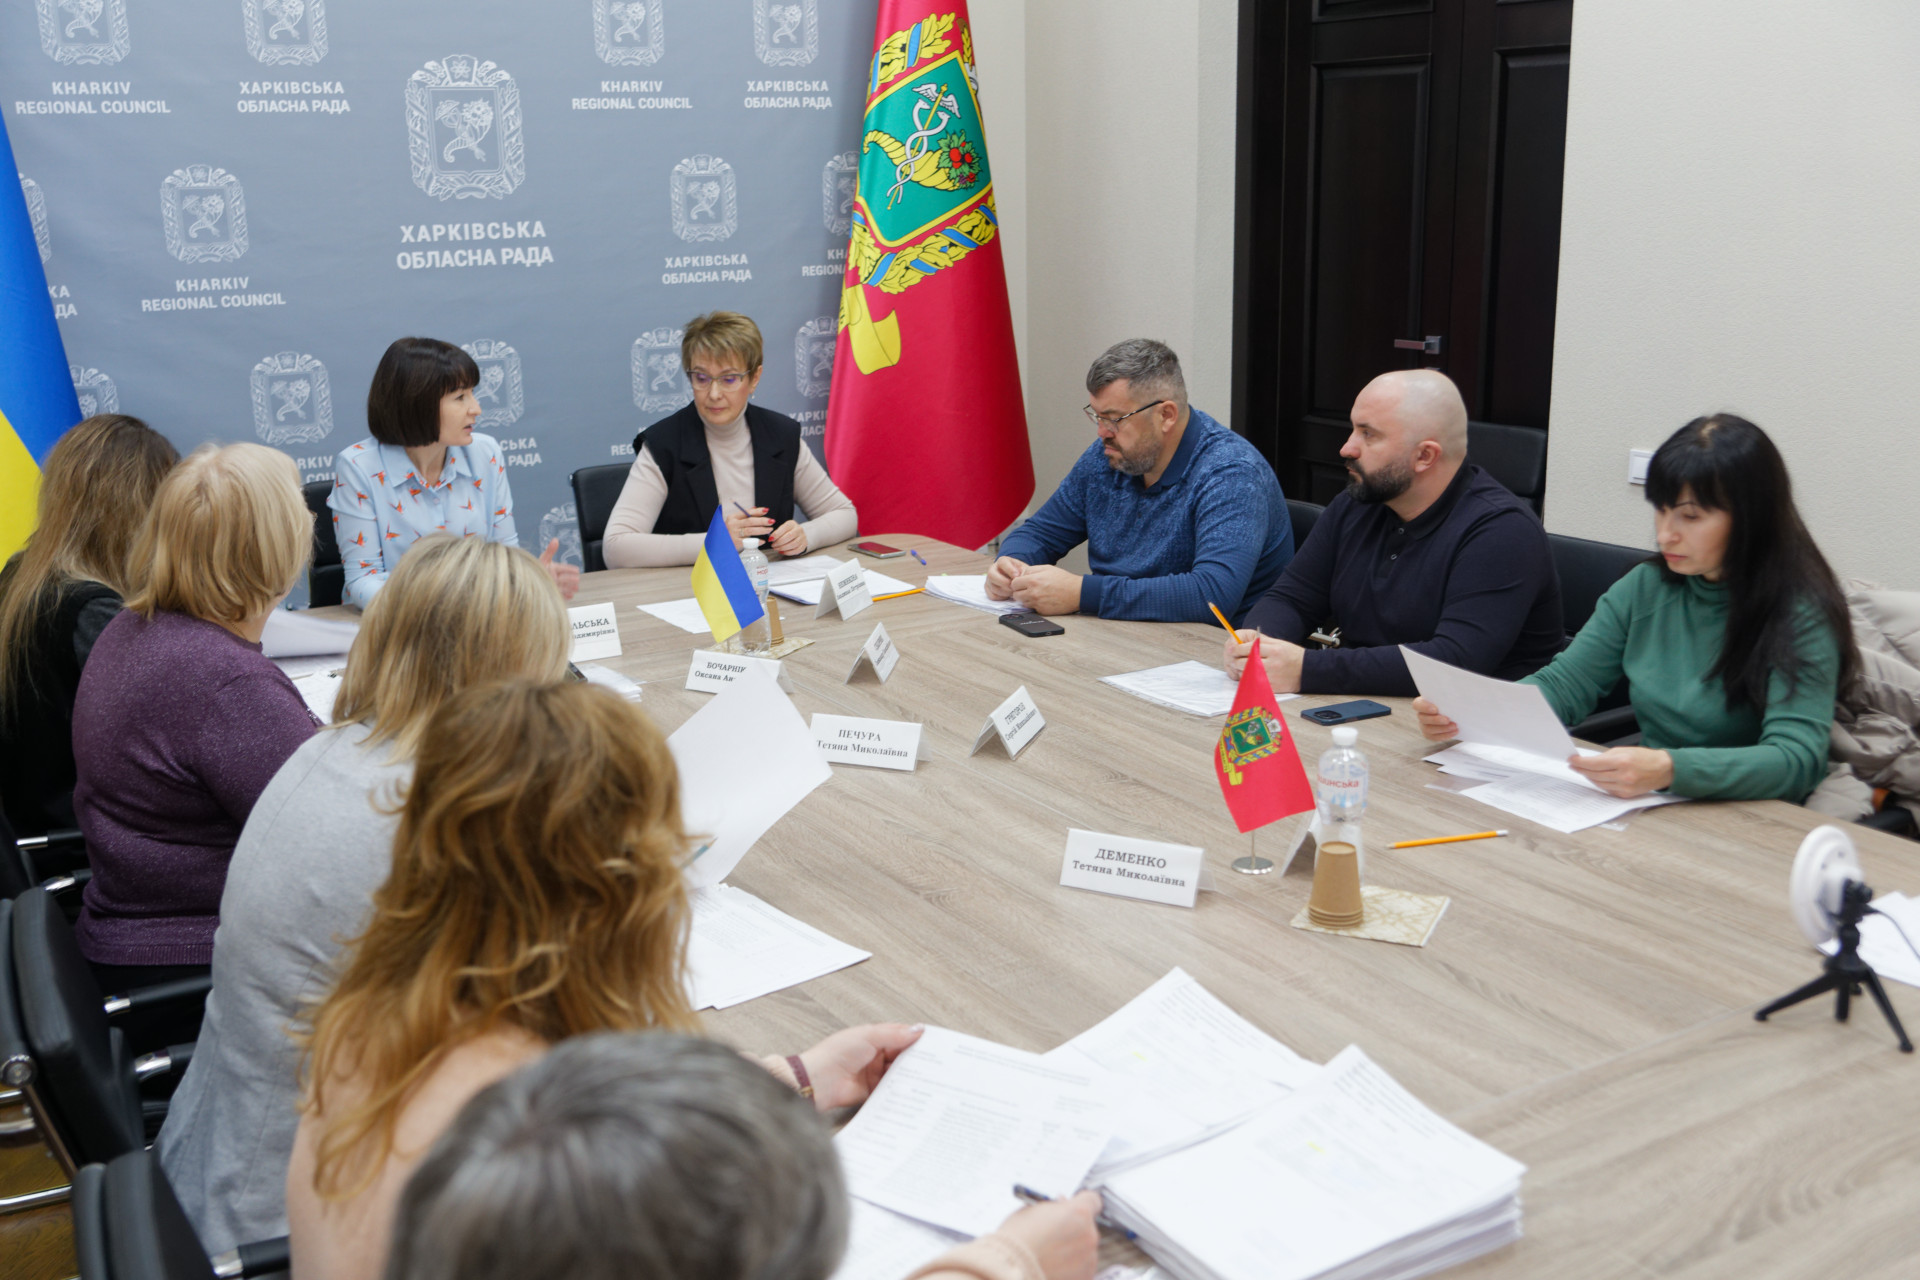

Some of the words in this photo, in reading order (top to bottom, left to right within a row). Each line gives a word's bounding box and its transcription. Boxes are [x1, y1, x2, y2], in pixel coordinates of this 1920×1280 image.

[52, 81, 131, 95] KHARKIV
[239, 81, 344, 94] ХАРКІВСЬКА
[601, 81, 663, 92] KHARKIV
[747, 80, 829, 92] ХАРКІВСЬКА
[15, 101, 97, 114] REGIONAL
[101, 100, 171, 114] COUNCIL
[237, 99, 309, 113] ОБЛАСНА
[311, 99, 351, 115] РАДА
[572, 97, 635, 110] REGIONAL
[638, 97, 693, 109] COUNCIL
[744, 97, 800, 109] ОБЛАСНА
[802, 97, 832, 110] РАДА
[400, 220, 546, 243] ХАРКІВСЬКА
[396, 249, 497, 270] ОБЛАСНА
[500, 246, 554, 268] РАДА
[664, 254, 749, 268] ХАРКІВСЬКА
[662, 271, 719, 285] ОБЛАСНА
[721, 269, 752, 282] РАДА
[801, 264, 843, 277] REGION
[175, 277, 249, 292] KHARKIV
[141, 296, 218, 312] REGIONAL
[220, 292, 287, 308] COUNCIL
[54, 303, 78, 319] ДА
[297, 455, 333, 469] RKIV
[508, 453, 542, 467] РАДА
[572, 618, 610, 630] ЛЬСЬКА
[706, 661, 747, 673] БОЧАРНІК
[694, 670, 721, 680] Оксана
[723, 674, 736, 682] Ан
[838, 729, 881, 741] ПЕЧУРА
[817, 740, 848, 751] Тетяна
[850, 743, 908, 758] Миколаївна
[1094, 848, 1167, 869] ДЕМЕНКО
[1072, 860, 1112, 875] Тетяна
[1116, 867, 1186, 887] Миколаївна
